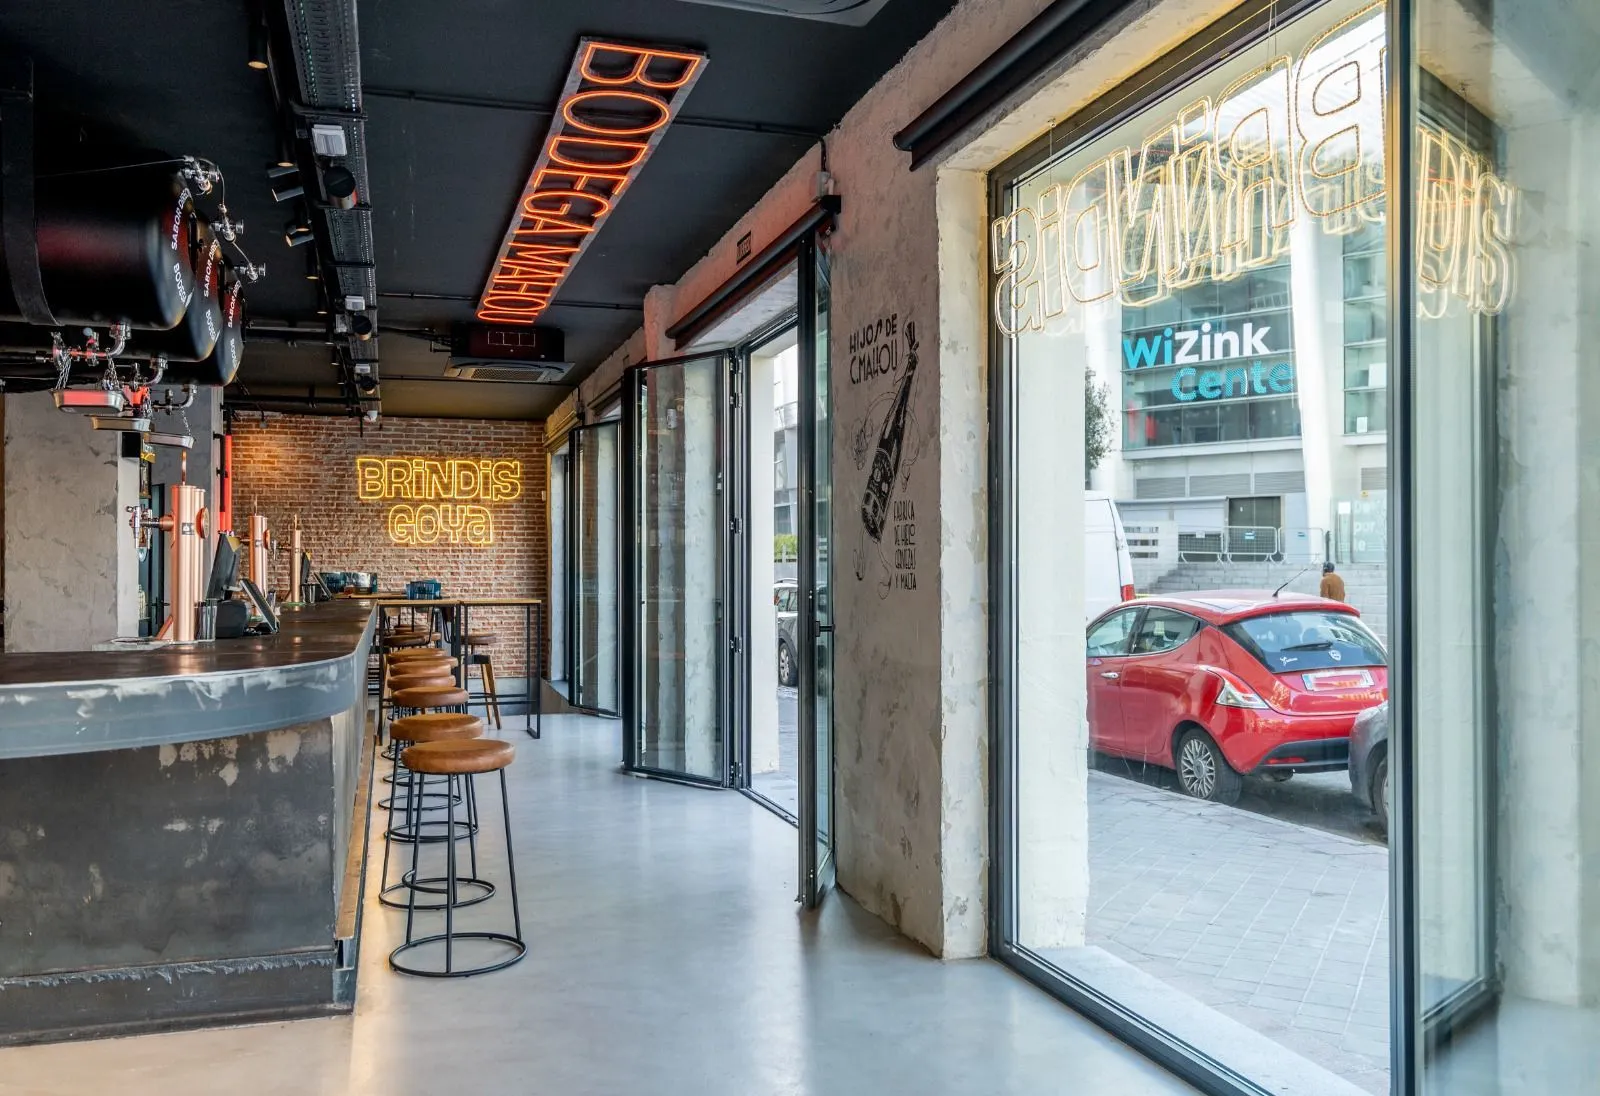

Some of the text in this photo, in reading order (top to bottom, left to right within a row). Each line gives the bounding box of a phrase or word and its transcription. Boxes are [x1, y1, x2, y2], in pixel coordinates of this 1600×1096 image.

[477, 42, 701, 323] BODEGA MAHOU
[849, 313, 898, 354] HIJOS DE
